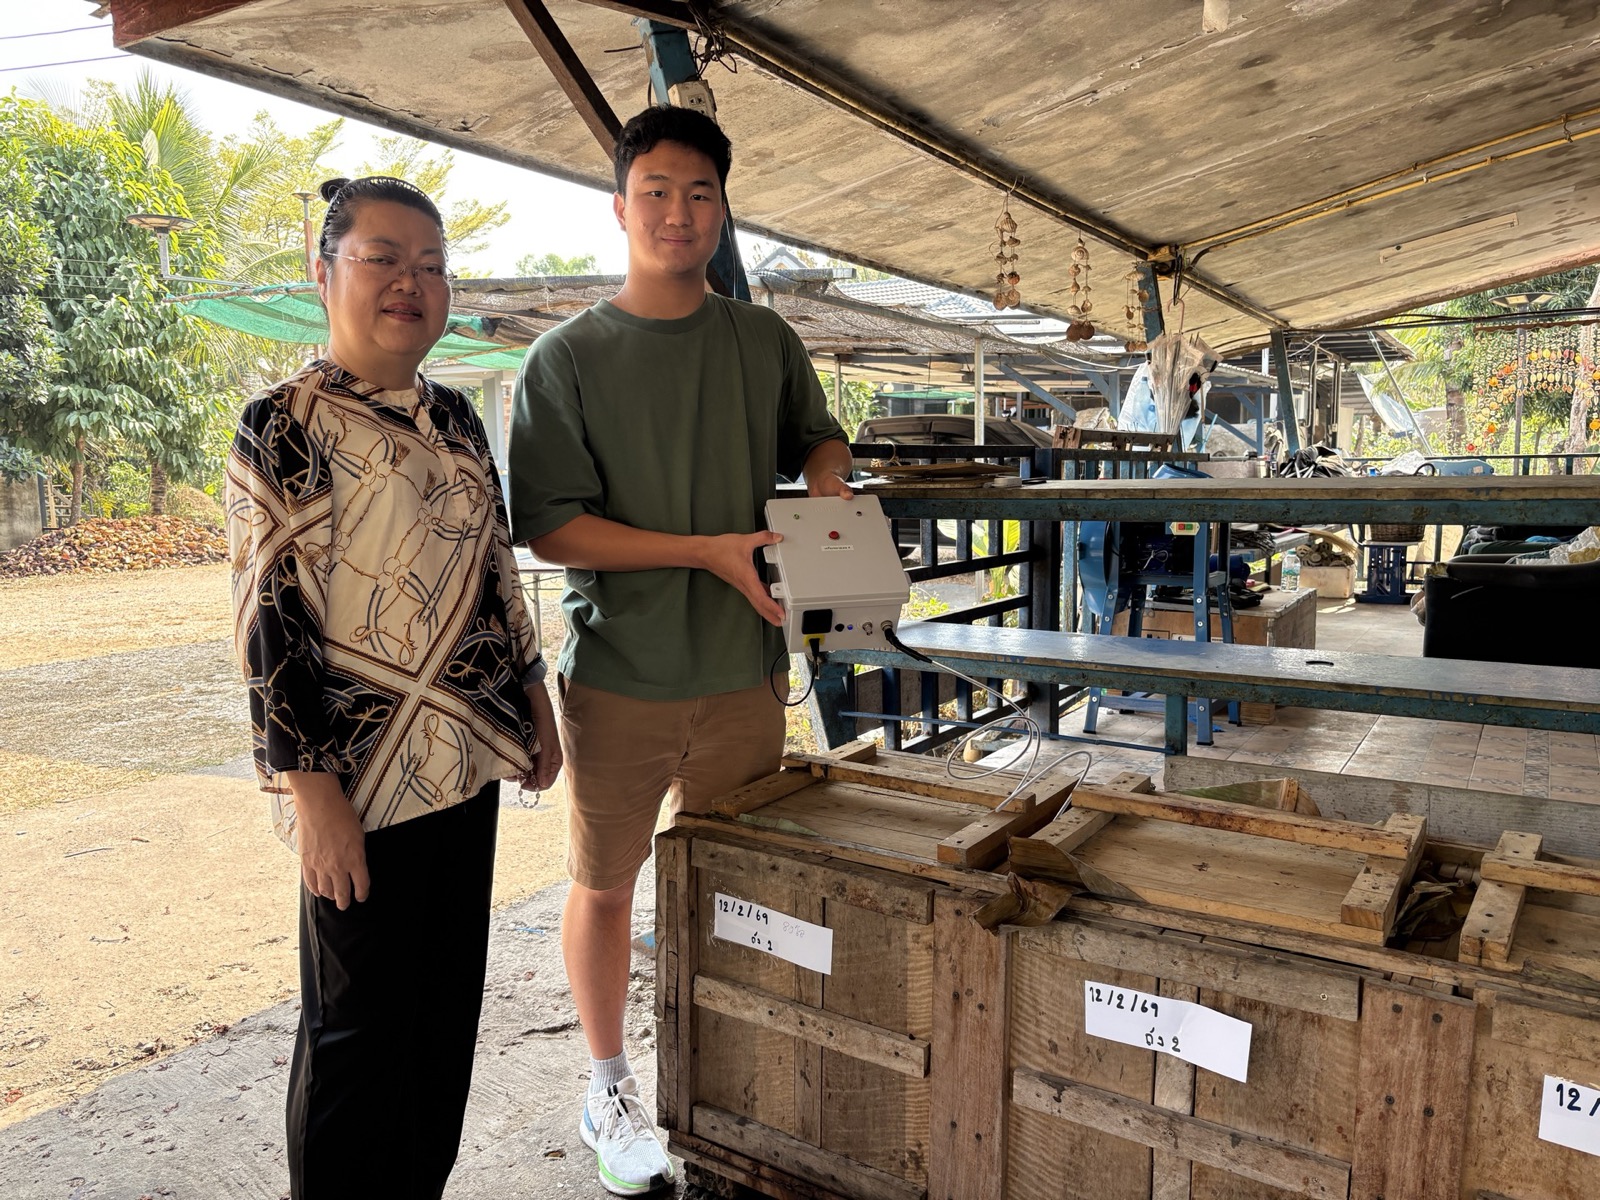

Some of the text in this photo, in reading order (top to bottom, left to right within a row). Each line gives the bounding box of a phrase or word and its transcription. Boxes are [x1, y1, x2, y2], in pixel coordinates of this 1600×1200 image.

[719, 899, 768, 925] 12/2/69
[1089, 986, 1159, 1017] 12/2/69
[1171, 1036, 1181, 1053] 2
